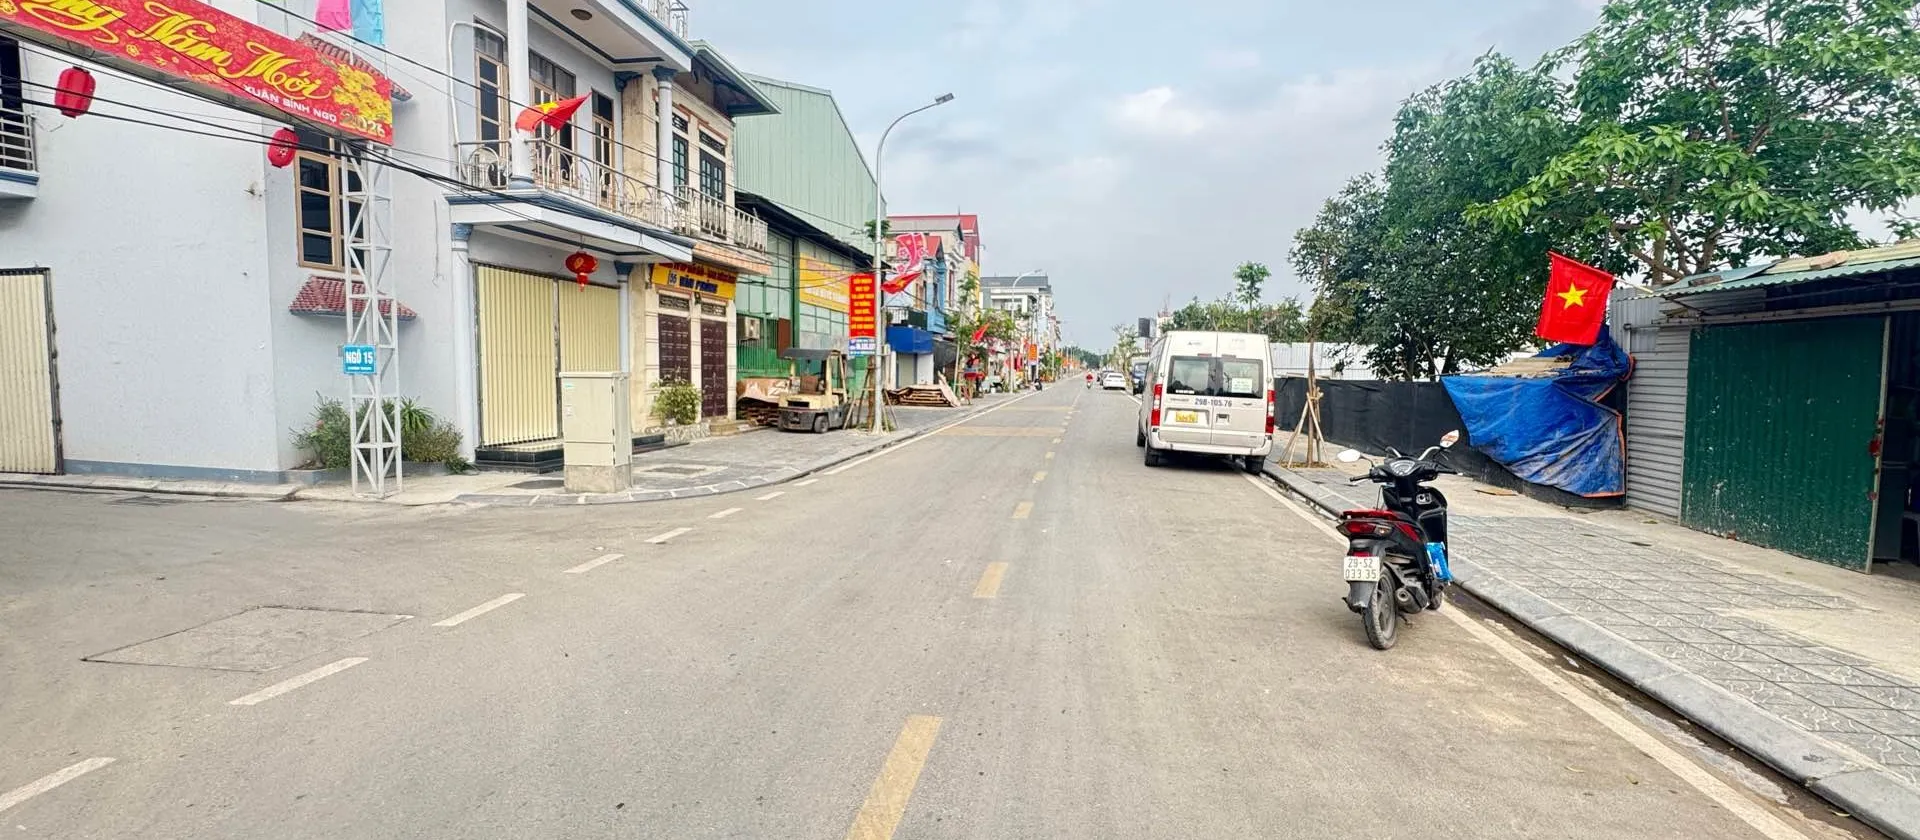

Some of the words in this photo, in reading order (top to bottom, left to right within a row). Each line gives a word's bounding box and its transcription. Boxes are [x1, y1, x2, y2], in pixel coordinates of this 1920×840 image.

[126, 1, 233, 67] Năm
[217, 41, 332, 100] Mới
[242, 84, 280, 104] XUÂN
[282, 97, 310, 114] BÍNH
[313, 107, 337, 124] NGỌ
[363, 351, 374, 365] 15
